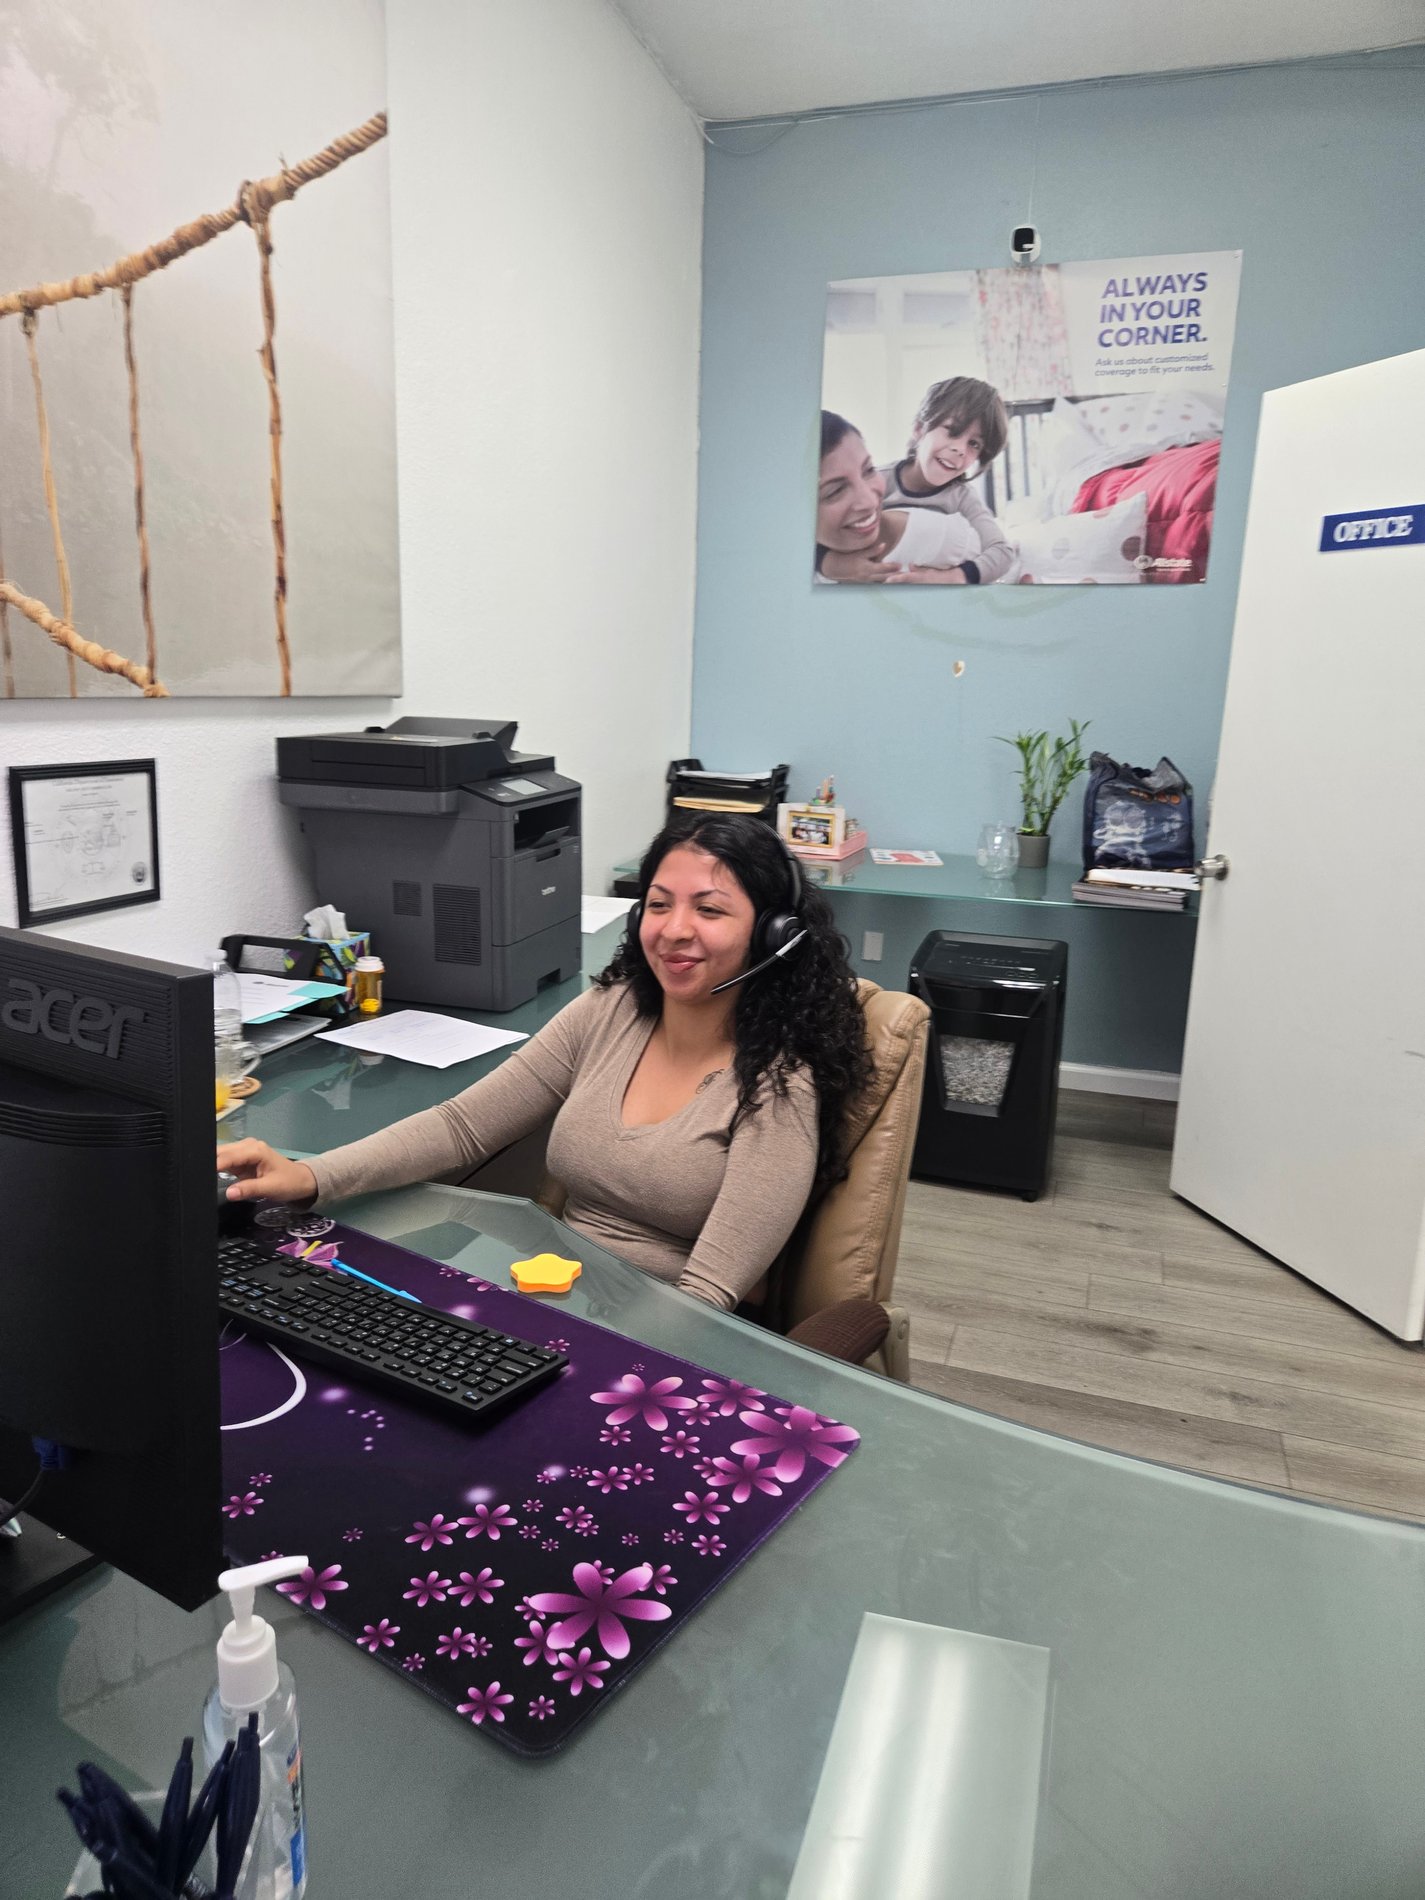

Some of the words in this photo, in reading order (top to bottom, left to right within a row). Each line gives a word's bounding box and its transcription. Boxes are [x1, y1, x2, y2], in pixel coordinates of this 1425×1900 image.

[1101, 272, 1208, 298] ALWAYS
[1100, 303, 1126, 323] IN
[1131, 298, 1202, 321] YOUR
[1098, 323, 1208, 347] CORNER.
[1095, 358, 1112, 366] Ask
[1126, 357, 1153, 365] about
[1095, 368, 1136, 377] coverage
[1149, 365, 1161, 374] fit
[1163, 366, 1183, 375] your
[1333, 514, 1414, 542] OFFICE
[2, 978, 145, 1059] acer
